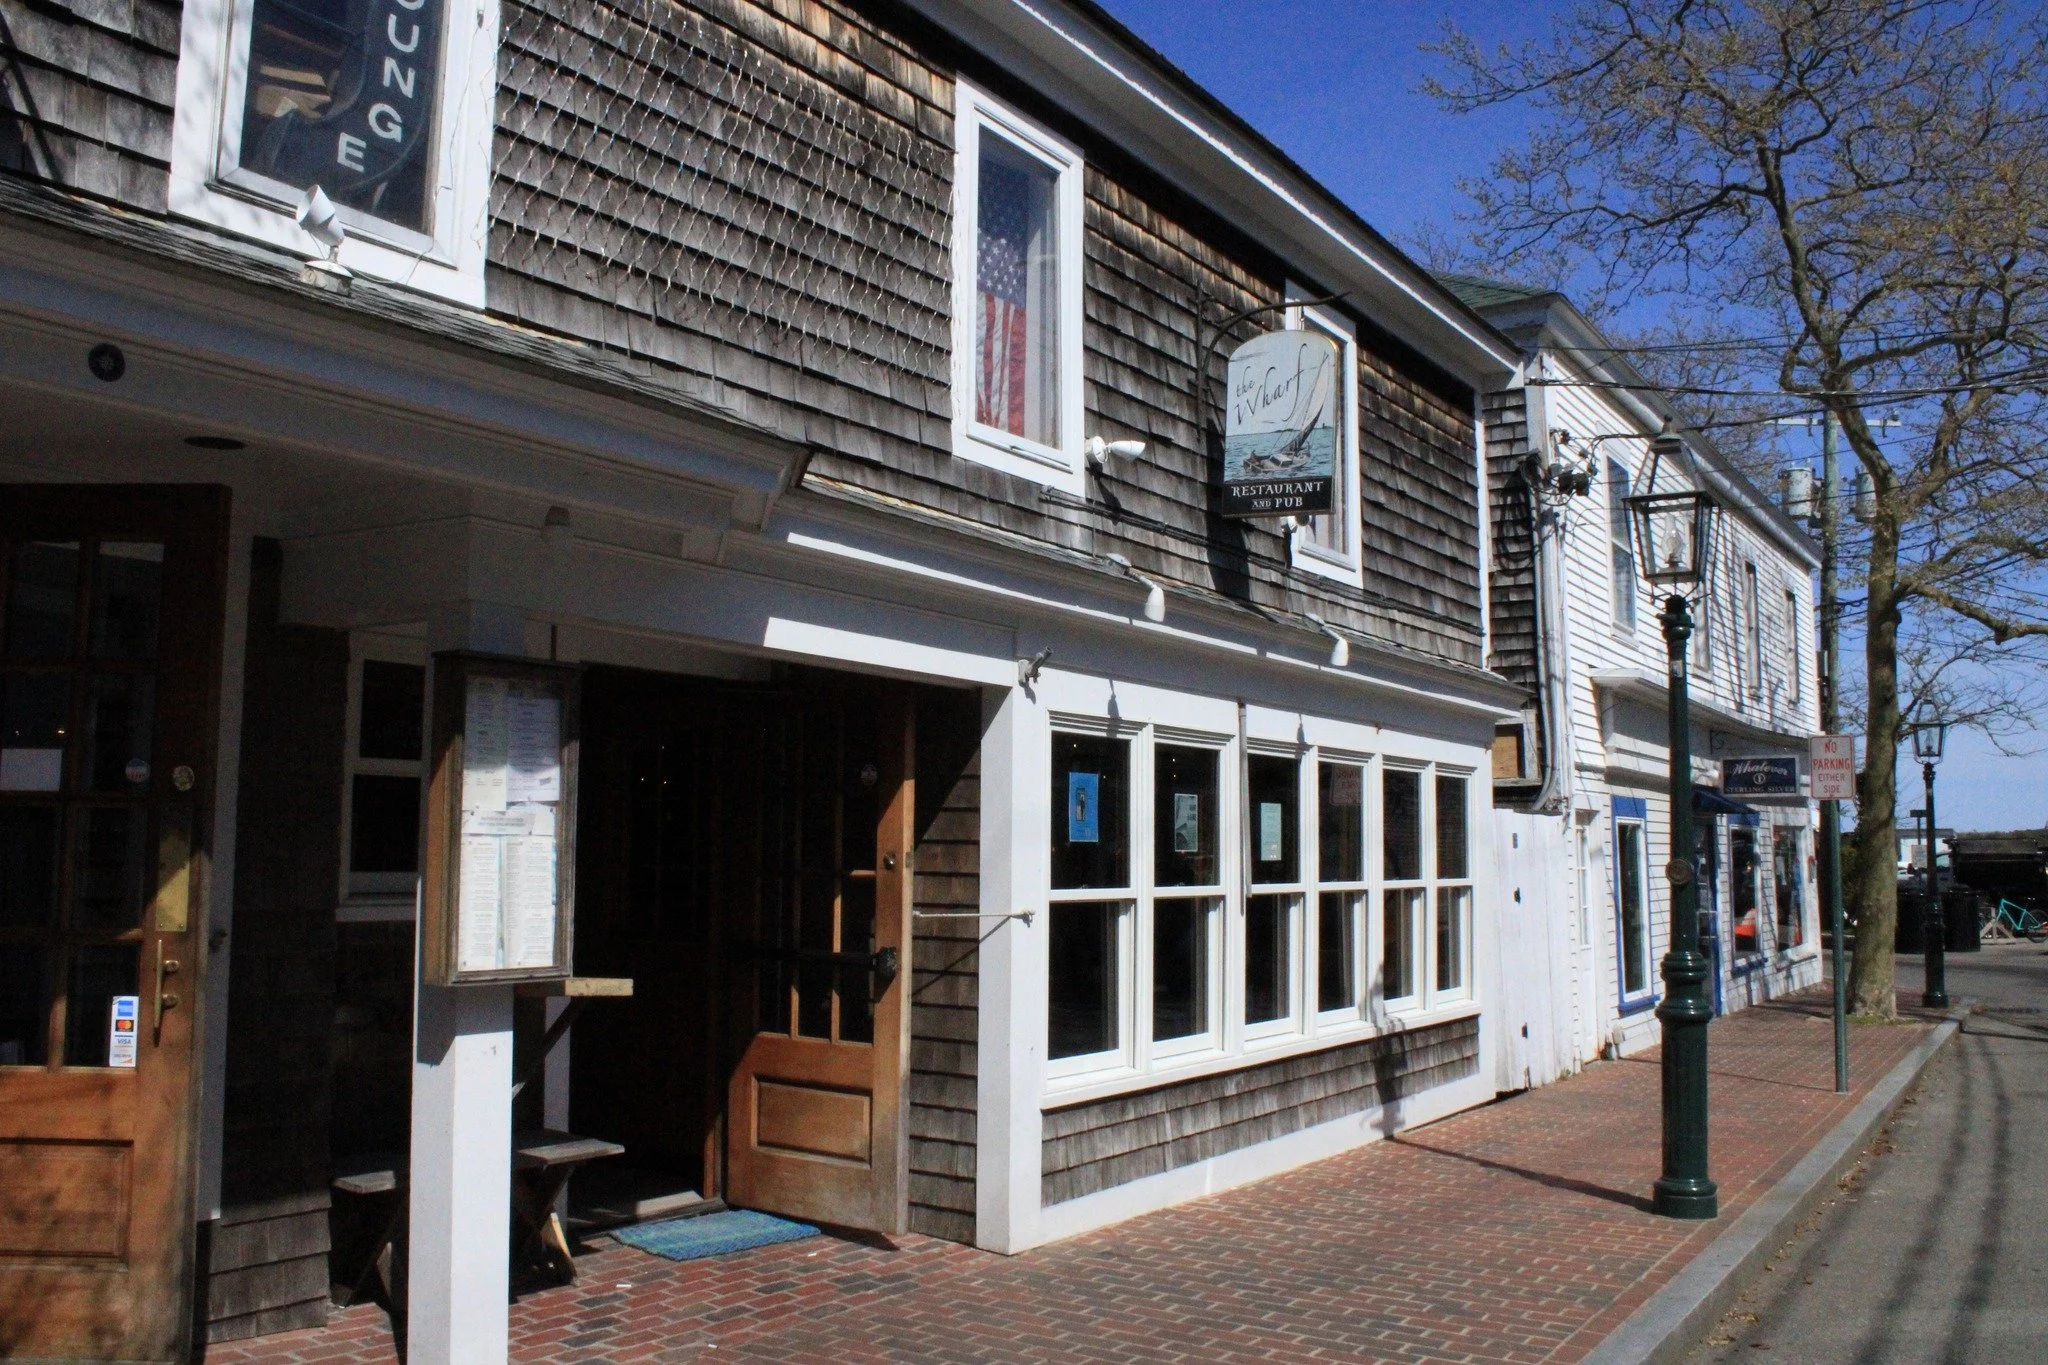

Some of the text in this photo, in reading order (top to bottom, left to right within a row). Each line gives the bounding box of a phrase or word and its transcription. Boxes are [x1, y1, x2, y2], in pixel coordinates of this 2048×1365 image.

[1234, 343, 1308, 426] Wharf
[1236, 366, 1255, 397] the
[1231, 481, 1324, 498] RESTAURANT
[1252, 497, 1304, 509] AND PUB
[1824, 742, 1837, 753] NO
[1813, 758, 1851, 771] PARKING
[1818, 774, 1846, 783] EITHER
[1823, 784, 1842, 794] SIDE
